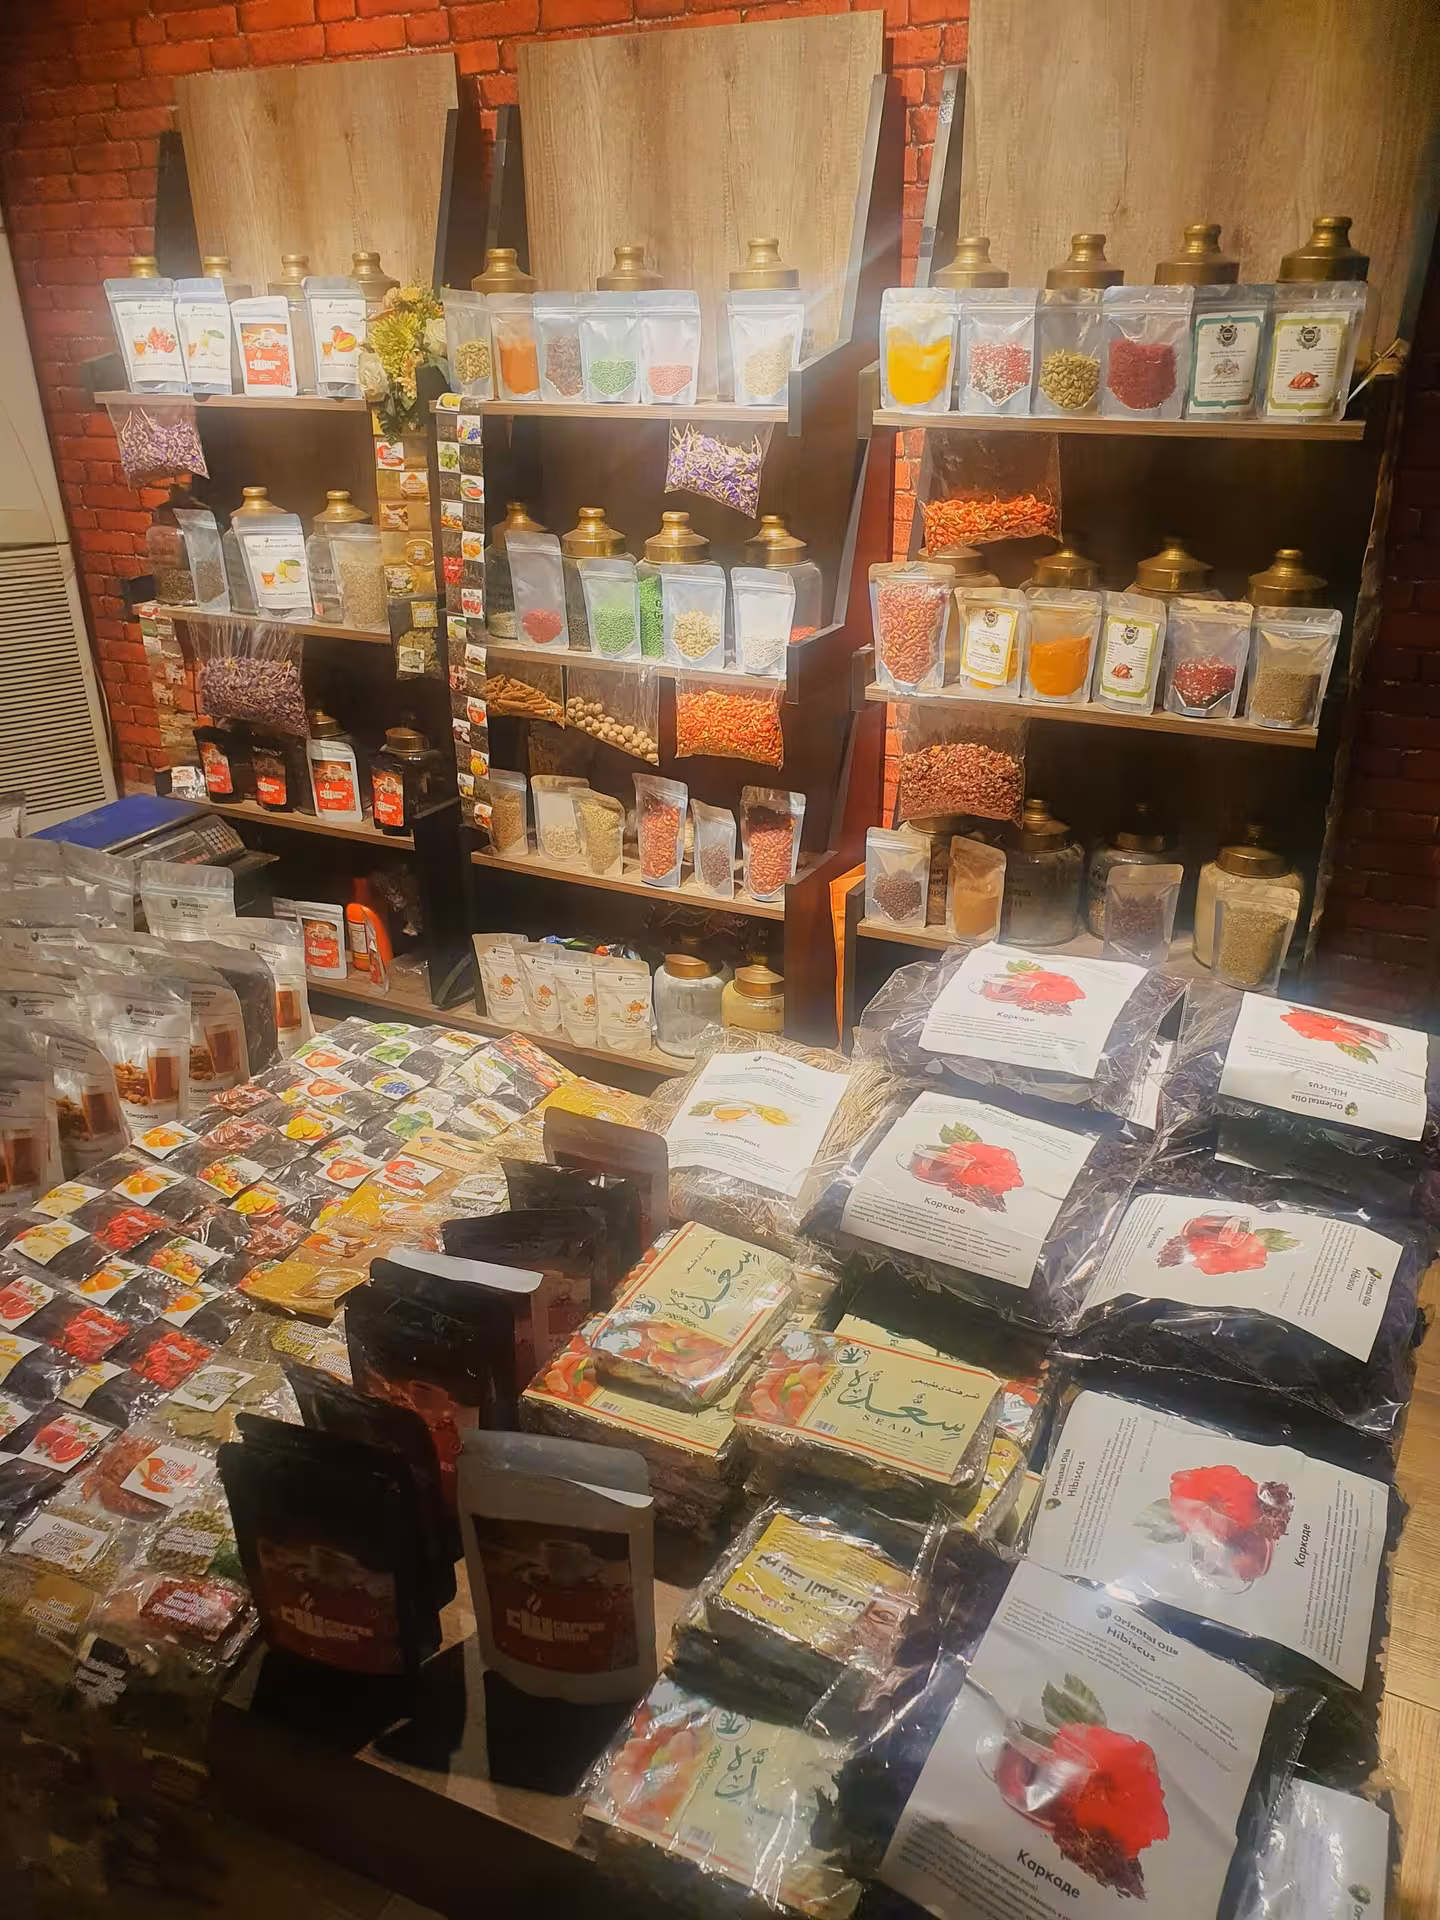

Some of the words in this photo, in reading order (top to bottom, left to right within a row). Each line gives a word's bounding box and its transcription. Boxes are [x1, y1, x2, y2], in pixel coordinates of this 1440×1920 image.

[1308, 1080, 1349, 1098] Hibiscus
[1311, 1095, 1343, 1112] Oriental
[923, 1194, 968, 1215] Каркаде
[1345, 1267, 1361, 1292] Hibiscus
[861, 1412, 926, 1440] SEADA
[1051, 1463, 1067, 1498] Oriental
[1061, 1447, 1072, 1464] Oils
[1066, 1459, 1086, 1498] Hibiscus
[52, 1522, 87, 1540] Oregano
[1293, 1522, 1311, 1568] Каркаде
[47, 1597, 72, 1614] Cumin
[1106, 1625, 1157, 1664] Hibiscus
[1111, 1612, 1155, 1648] Oriental
[1156, 1638, 1180, 1657] Oils
[1015, 1848, 1082, 1900] Каркаде
